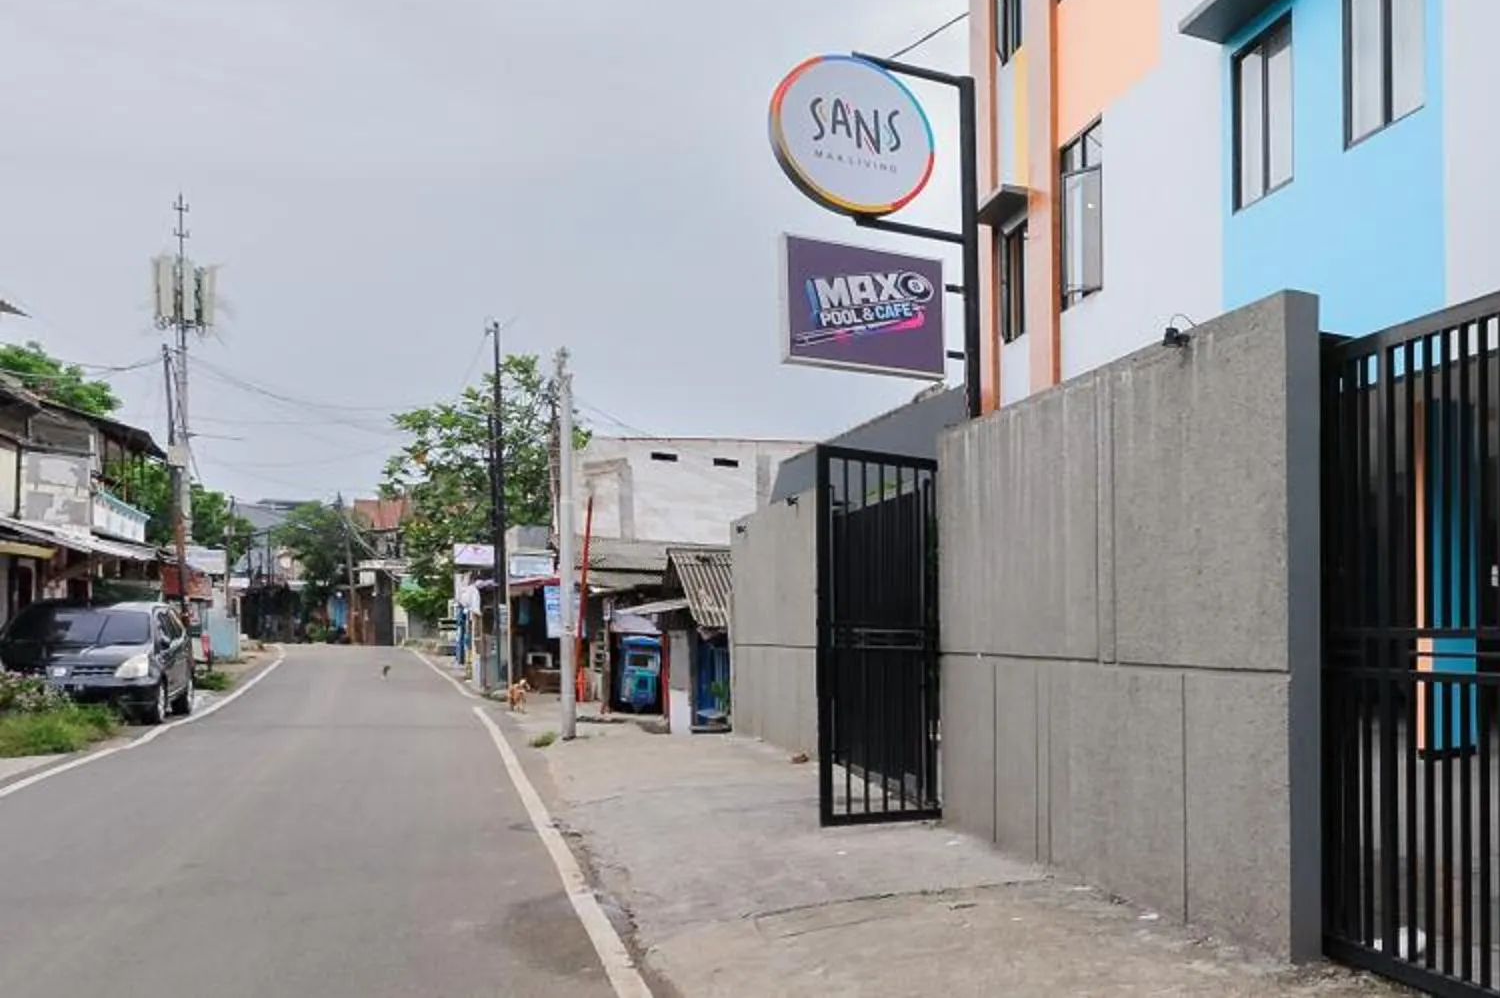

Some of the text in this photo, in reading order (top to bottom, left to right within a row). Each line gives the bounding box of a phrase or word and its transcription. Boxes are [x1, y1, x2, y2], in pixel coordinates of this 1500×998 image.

[810, 97, 901, 154] SANS
[815, 273, 904, 309] MAX
[820, 303, 912, 326] POOL & CAFE
